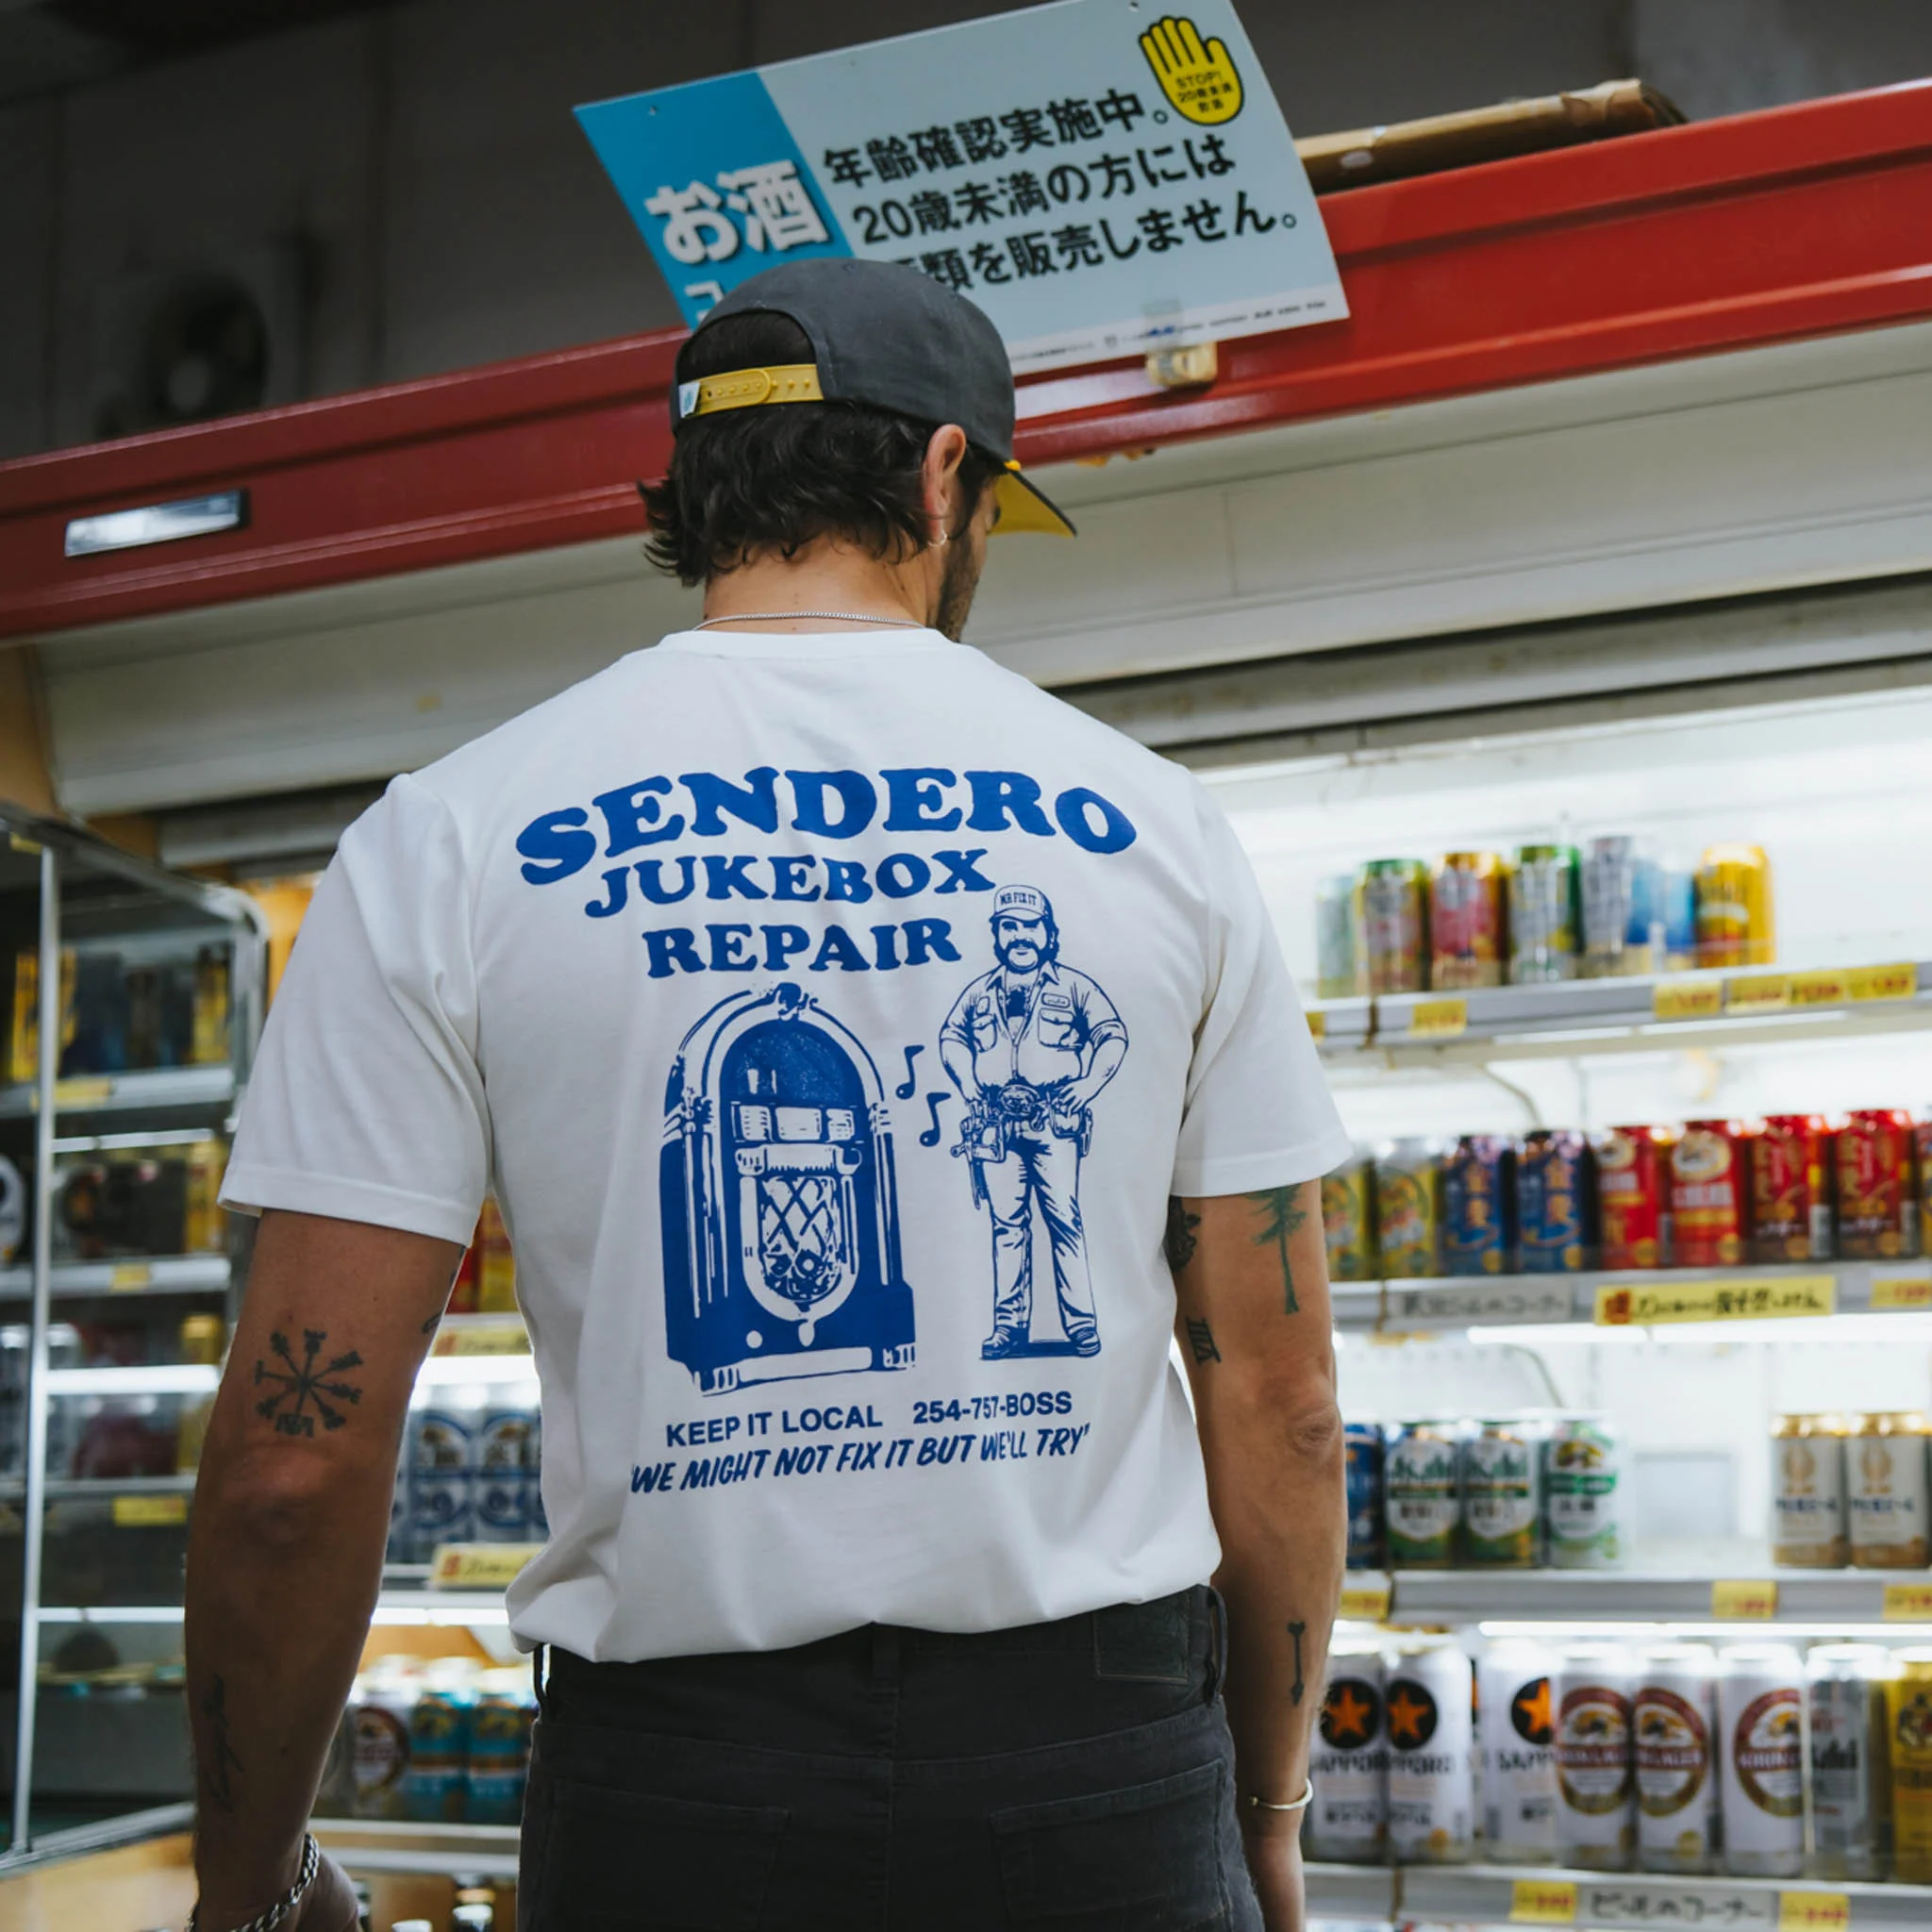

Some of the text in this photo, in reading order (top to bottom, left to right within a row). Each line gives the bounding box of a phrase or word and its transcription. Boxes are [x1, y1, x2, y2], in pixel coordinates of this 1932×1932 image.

[823, 87, 1169, 190] 年齢確認実施中。
[643, 158, 832, 265] お酒
[852, 133, 1236, 246] 20歳未満の方には
[892, 190, 1297, 291] 類を販売しません。
[515, 766, 1137, 885] SENDERO
[584, 848, 996, 919] JUKEBOX
[641, 917, 962, 978] REPAIR
[666, 1404, 883, 1447] KEEP IT LOCAL
[913, 1391, 1073, 1424] 254-757-BOSS
[679, 1449, 772, 1491] MIGHT
[773, 1444, 834, 1477] NOT
[836, 1441, 882, 1473] FIX
[884, 1439, 914, 1469] IT
[916, 1434, 976, 1466] BUT
[980, 1430, 1027, 1461] WE'LL
